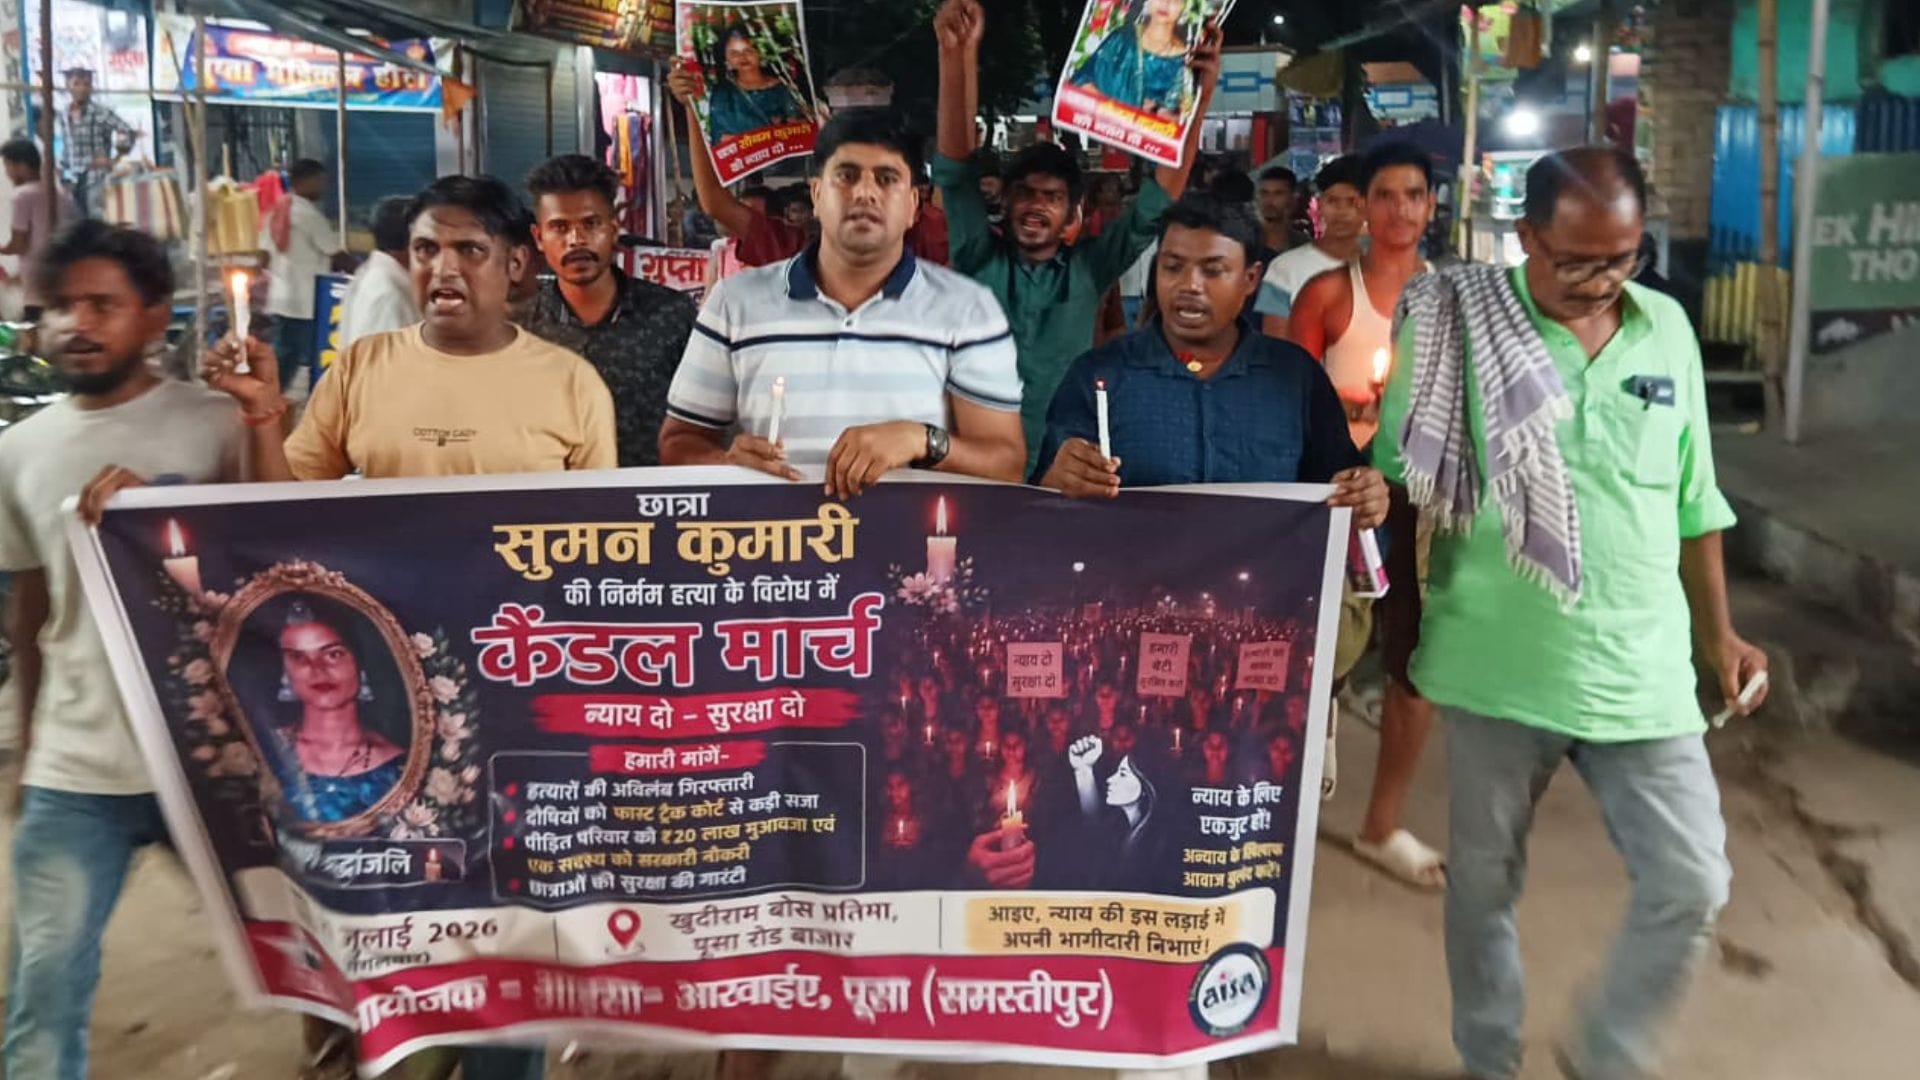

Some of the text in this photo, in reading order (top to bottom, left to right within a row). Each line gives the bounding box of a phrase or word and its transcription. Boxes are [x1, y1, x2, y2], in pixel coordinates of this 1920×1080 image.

[639, 252, 709, 285] गुप्ता
[636, 492, 710, 518] छात्रा
[493, 502, 860, 581] सुमन कुमारी
[563, 572, 841, 608] की निर्मम हत्या के विरोध में
[471, 591, 884, 687] कैंडल मार्च
[584, 703, 642, 728] न्याय
[650, 698, 673, 730] दो
[706, 698, 774, 732] सुरक्षा
[780, 691, 806, 718] दो
[624, 747, 675, 771] हमारी
[526, 772, 755, 801] हत्यारों की अविलंब गिरफ्तारी
[1191, 781, 1283, 807] न्याय के लिए
[525, 791, 820, 826] दोषियों को फास्ट ट्रैक कोर्ट से कड़ी सजा
[524, 831, 573, 854] पीड़ित
[576, 825, 631, 846] परिवार
[633, 826, 657, 844] को
[701, 824, 741, 840] लाख
[745, 817, 807, 840] मुआवजा
[812, 814, 836, 832] एवं
[1200, 815, 1249, 841] एकजुट
[527, 858, 554, 875] एक
[611, 850, 633, 867] को
[638, 848, 697, 867] सरकारी
[1183, 848, 1227, 864] अन्याय
[528, 865, 746, 897] छात्राओं की सुरक्षा की गारंटी
[669, 895, 898, 934] खुदीराम बोस प्रतिमा,
[988, 902, 1226, 933] आइए, न्याय की इस लड़ाई में
[428, 918, 498, 945] 2026
[694, 925, 855, 959] पूसा रोड बाजार
[1002, 927, 1051, 948] अपनी
[1059, 927, 1140, 952] भागीदारी
[843, 974, 911, 1025] पूसा
[922, 966, 1113, 1031] (समस्तीपुर)
[1203, 971, 1256, 1009] aisa
